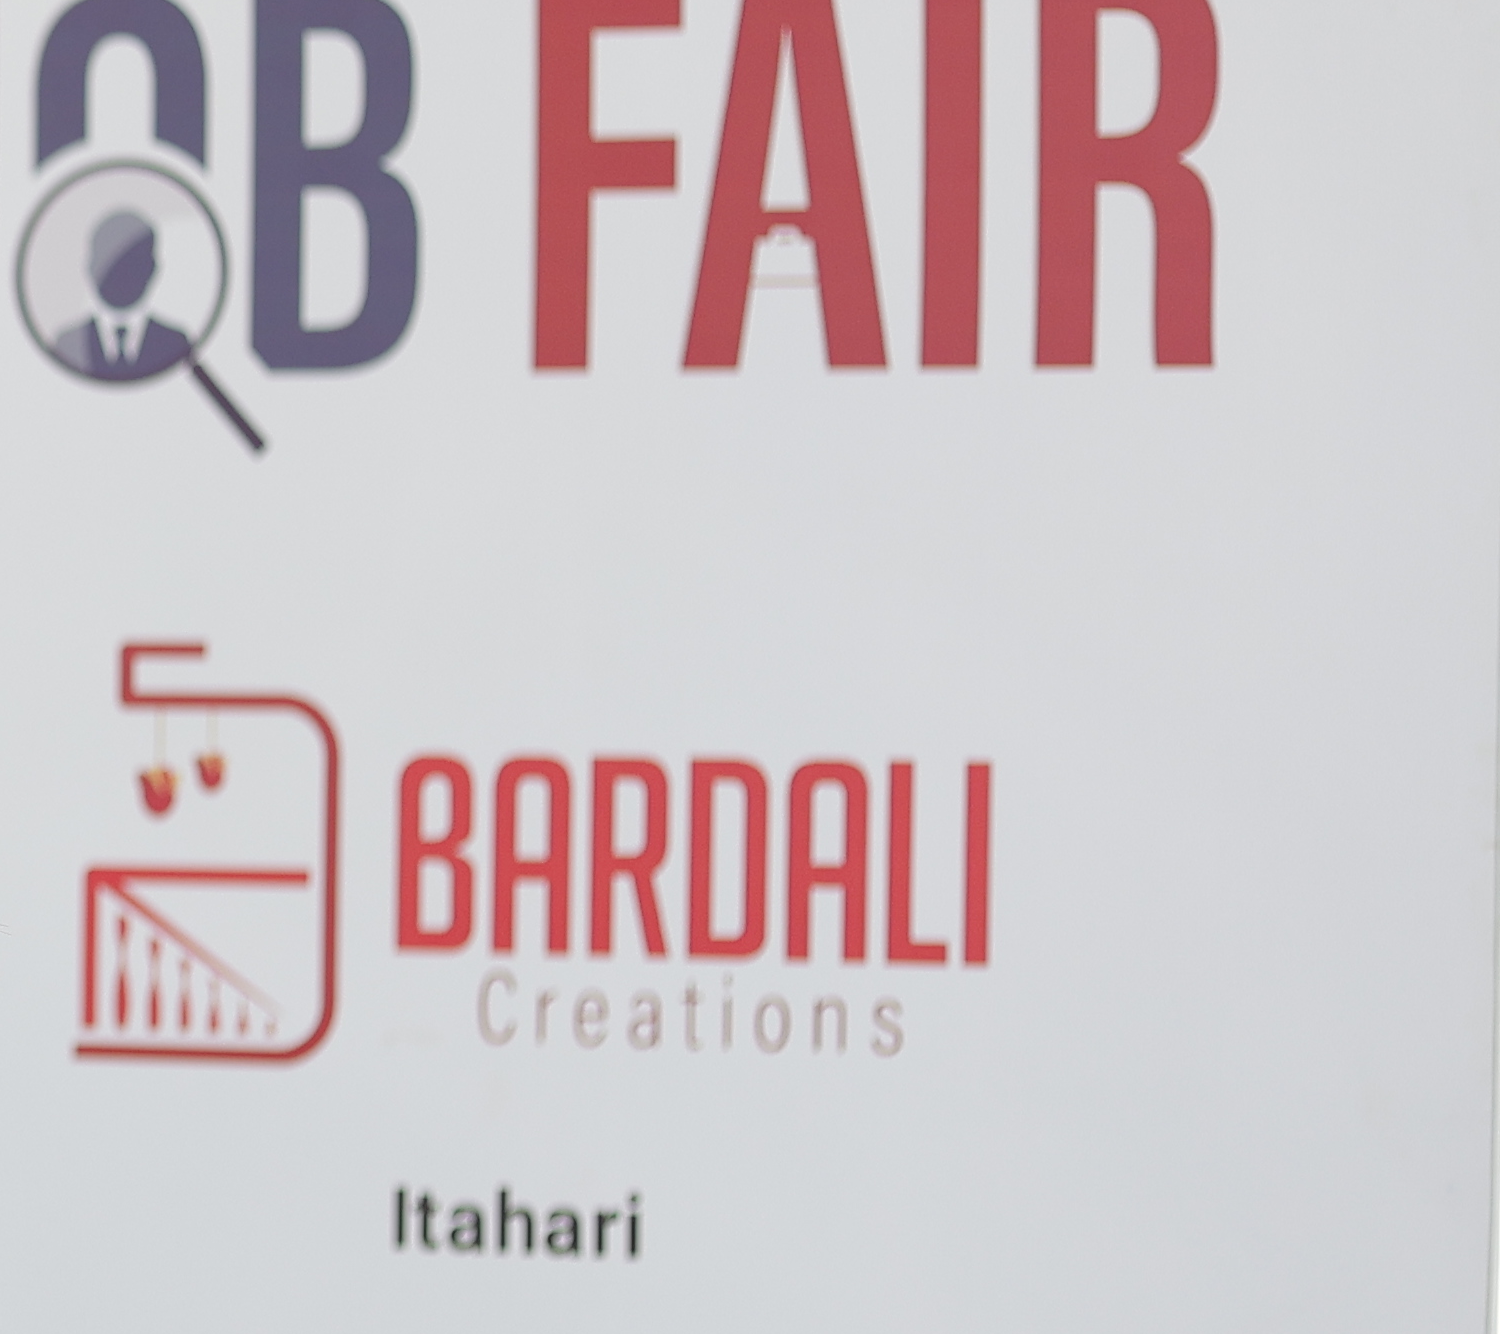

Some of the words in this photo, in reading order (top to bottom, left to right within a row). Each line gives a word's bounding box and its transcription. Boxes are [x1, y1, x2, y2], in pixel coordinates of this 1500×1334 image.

[394, 752, 993, 968] BARDALI
[476, 965, 906, 1058] Creations
[393, 1184, 645, 1259] Itahari
